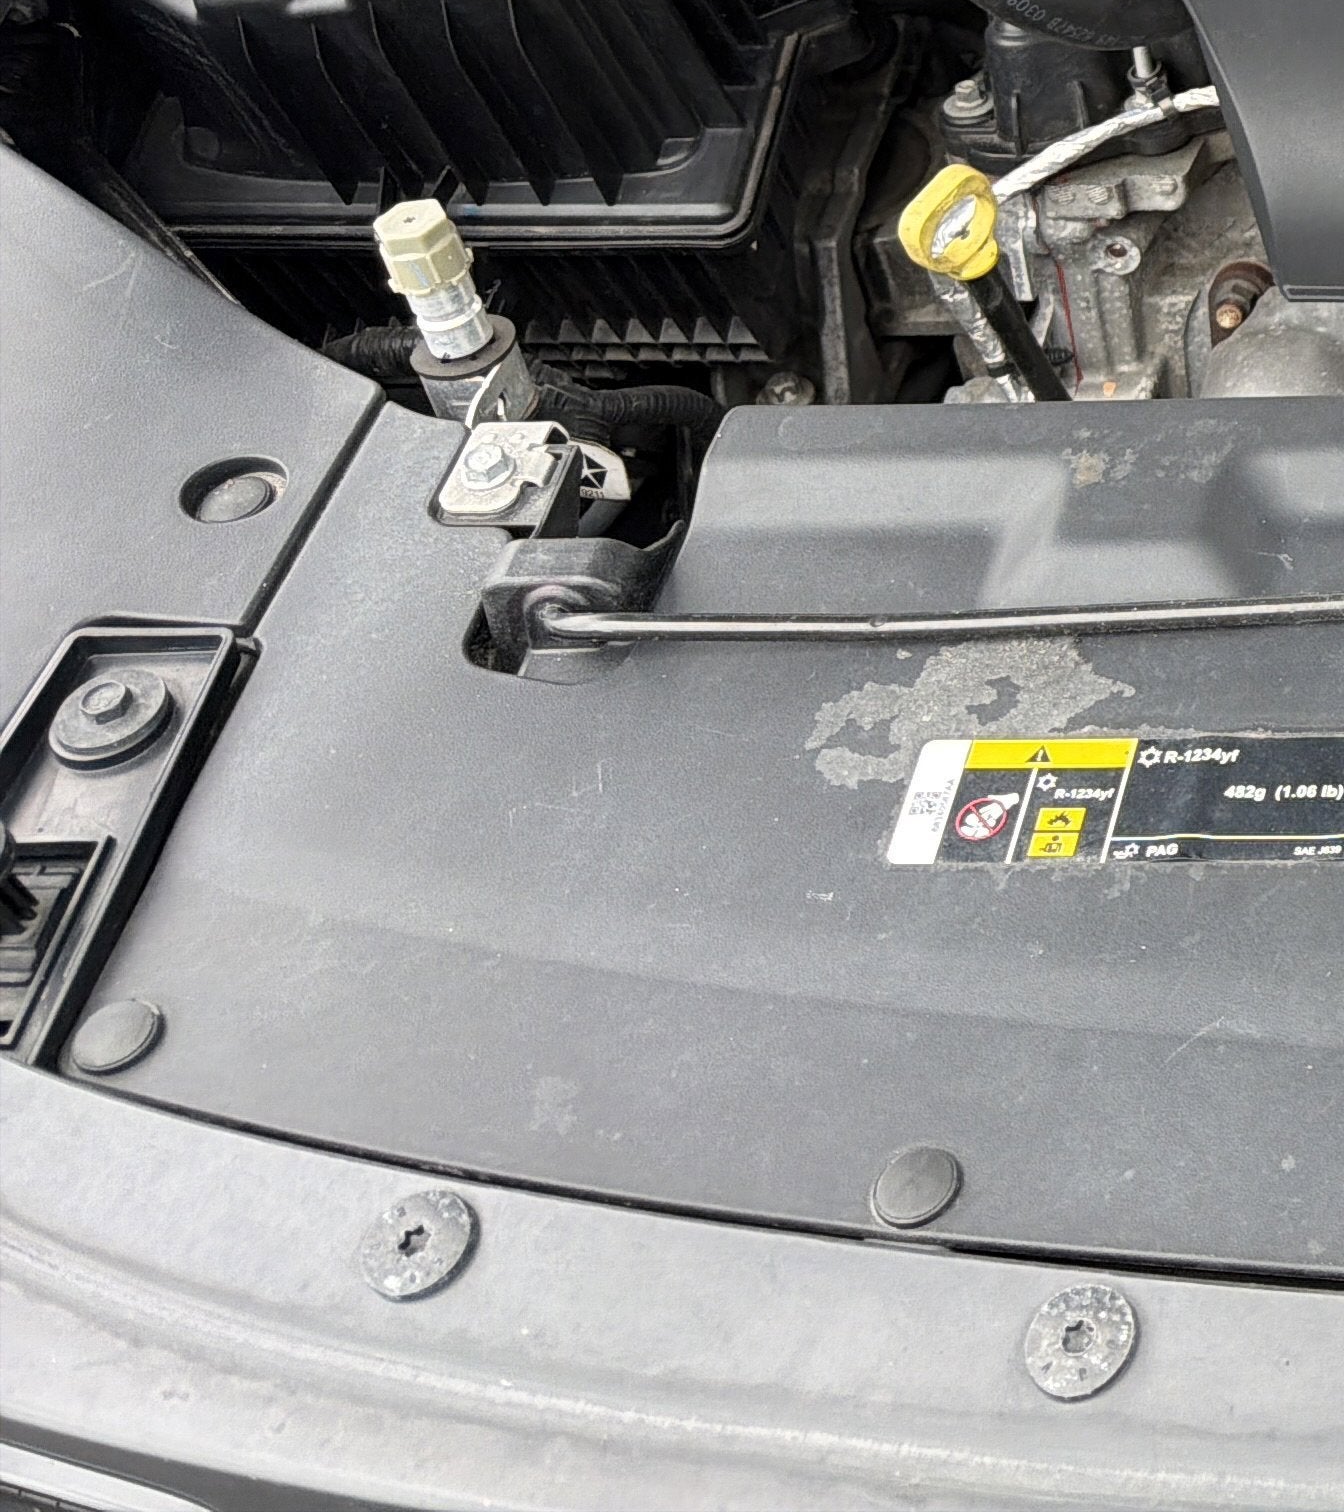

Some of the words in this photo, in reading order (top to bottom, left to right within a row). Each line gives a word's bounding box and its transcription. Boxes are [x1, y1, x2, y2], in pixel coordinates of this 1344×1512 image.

[1163, 747, 1241, 765] R-1234yf
[1053, 787, 1116, 801] R-1234yf
[1223, 784, 1267, 802] 482g
[1274, 784, 1319, 801] (1.06
[1145, 843, 1180, 857] PAG
[1293, 846, 1316, 856] SAE
